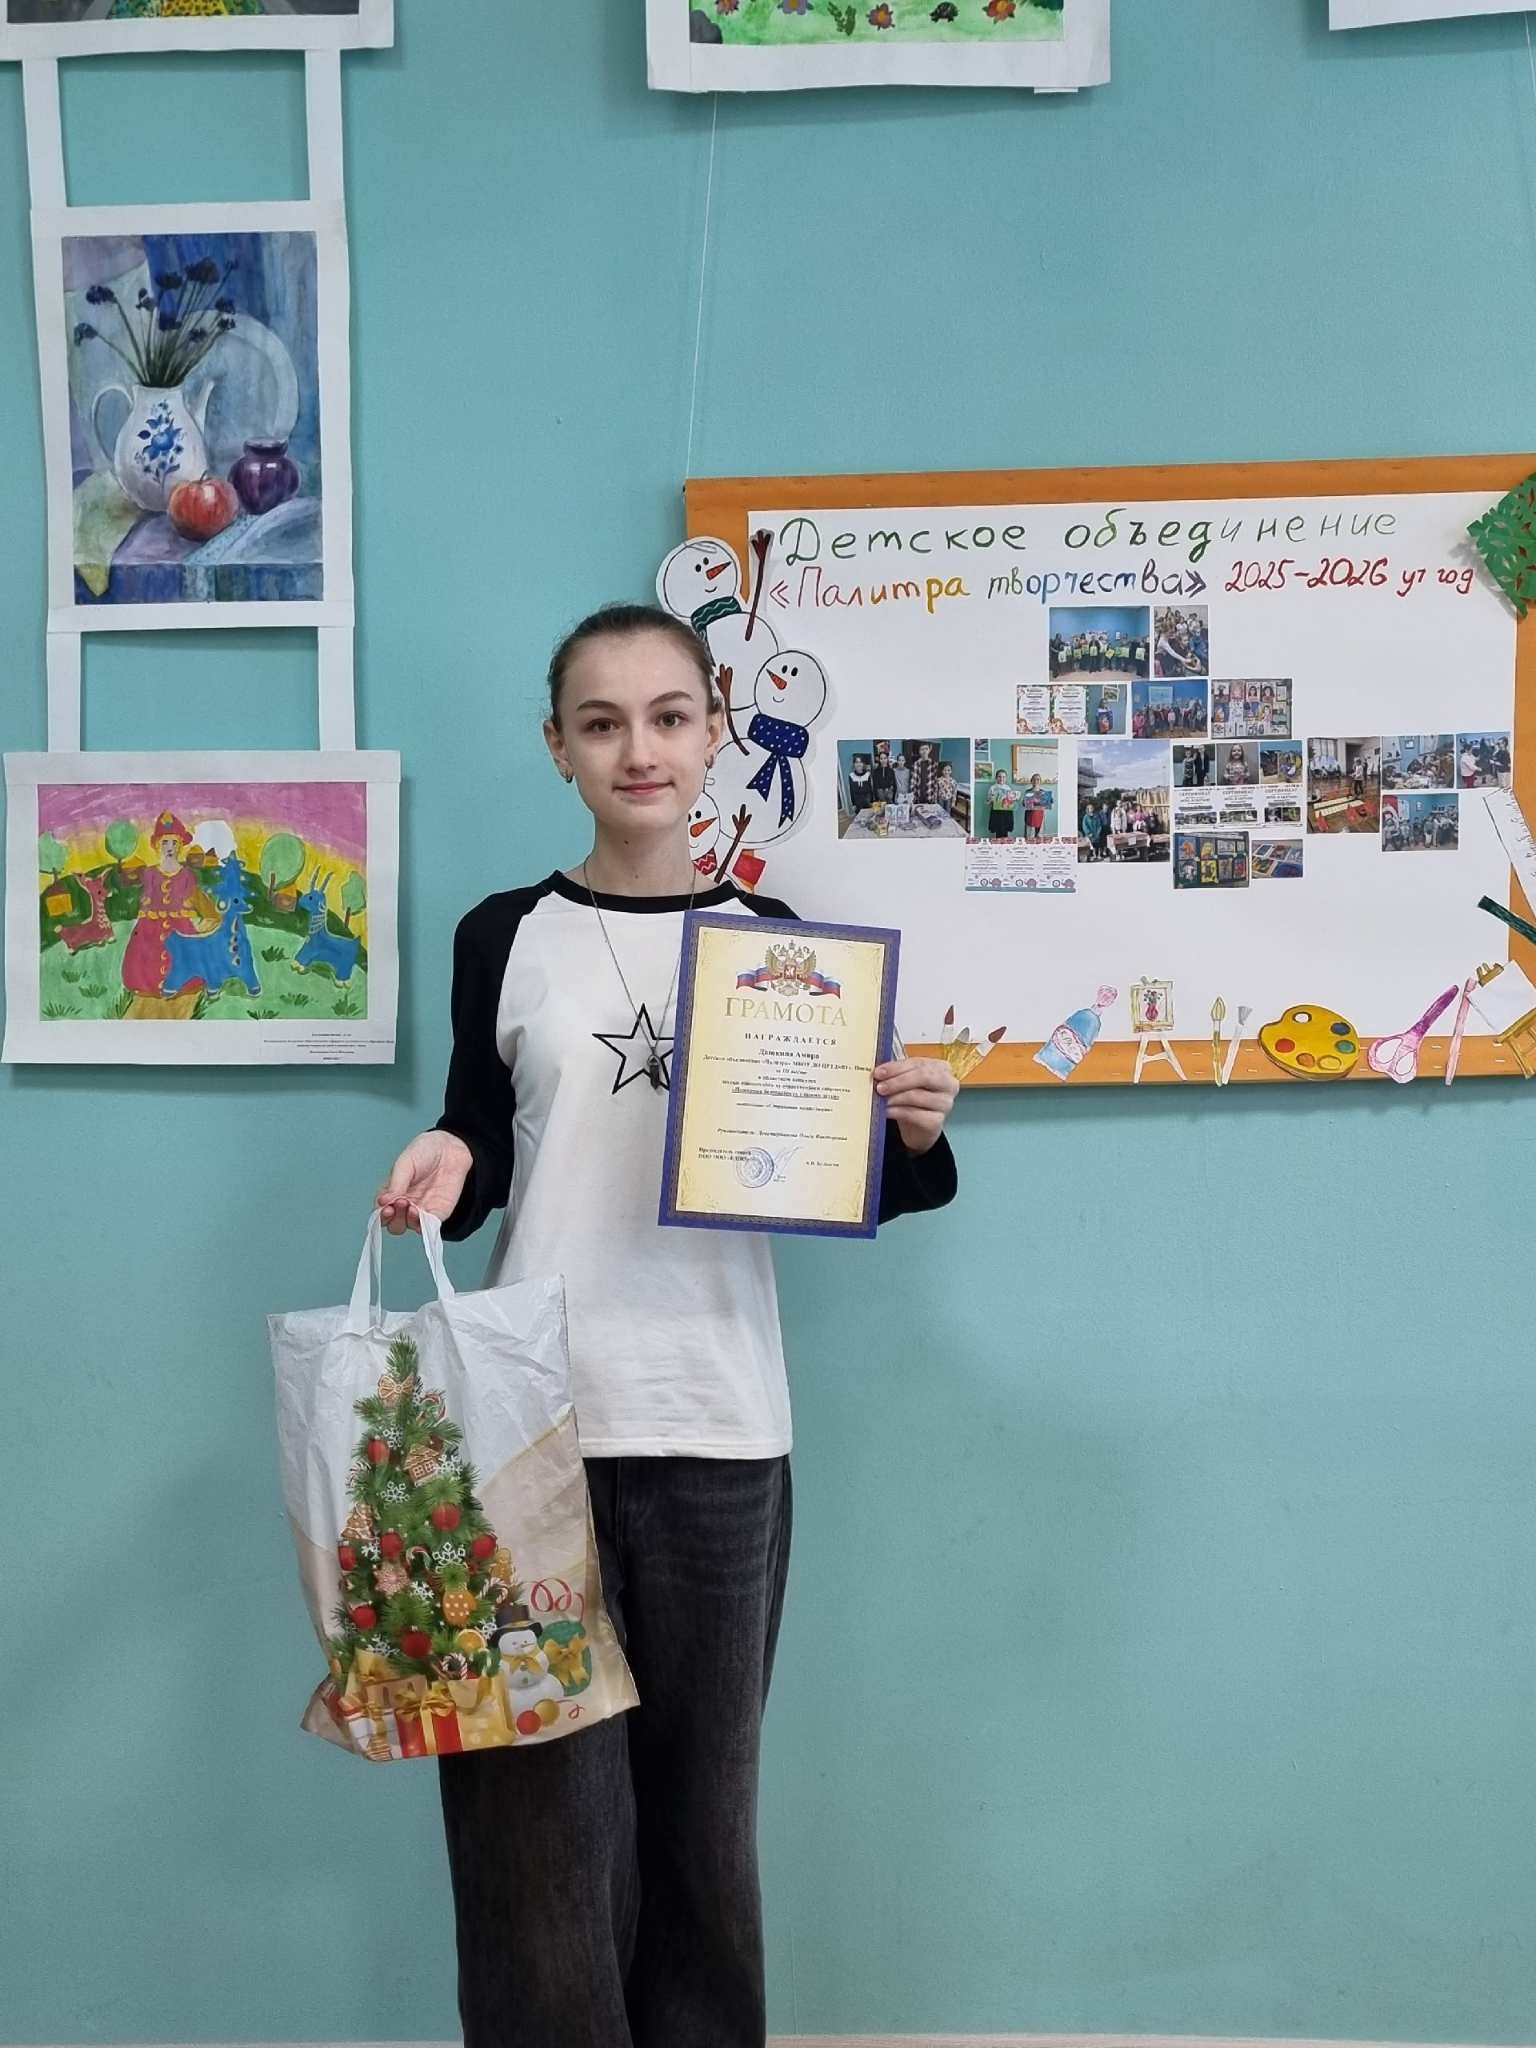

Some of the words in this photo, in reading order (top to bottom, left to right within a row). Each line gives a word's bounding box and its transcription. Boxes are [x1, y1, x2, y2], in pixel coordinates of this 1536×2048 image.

[779, 517, 1026, 566] Детское
[1065, 508, 1396, 563] объединение
[769, 566, 970, 614] «Палитра
[988, 558, 1208, 605] творчества»
[1224, 557, 1388, 594] 2025-2026
[1437, 567, 1474, 595] год
[724, 997, 848, 1027] ГРАМОТА
[744, 1032, 837, 1046] НАГРАЖДАЕТСЯ
